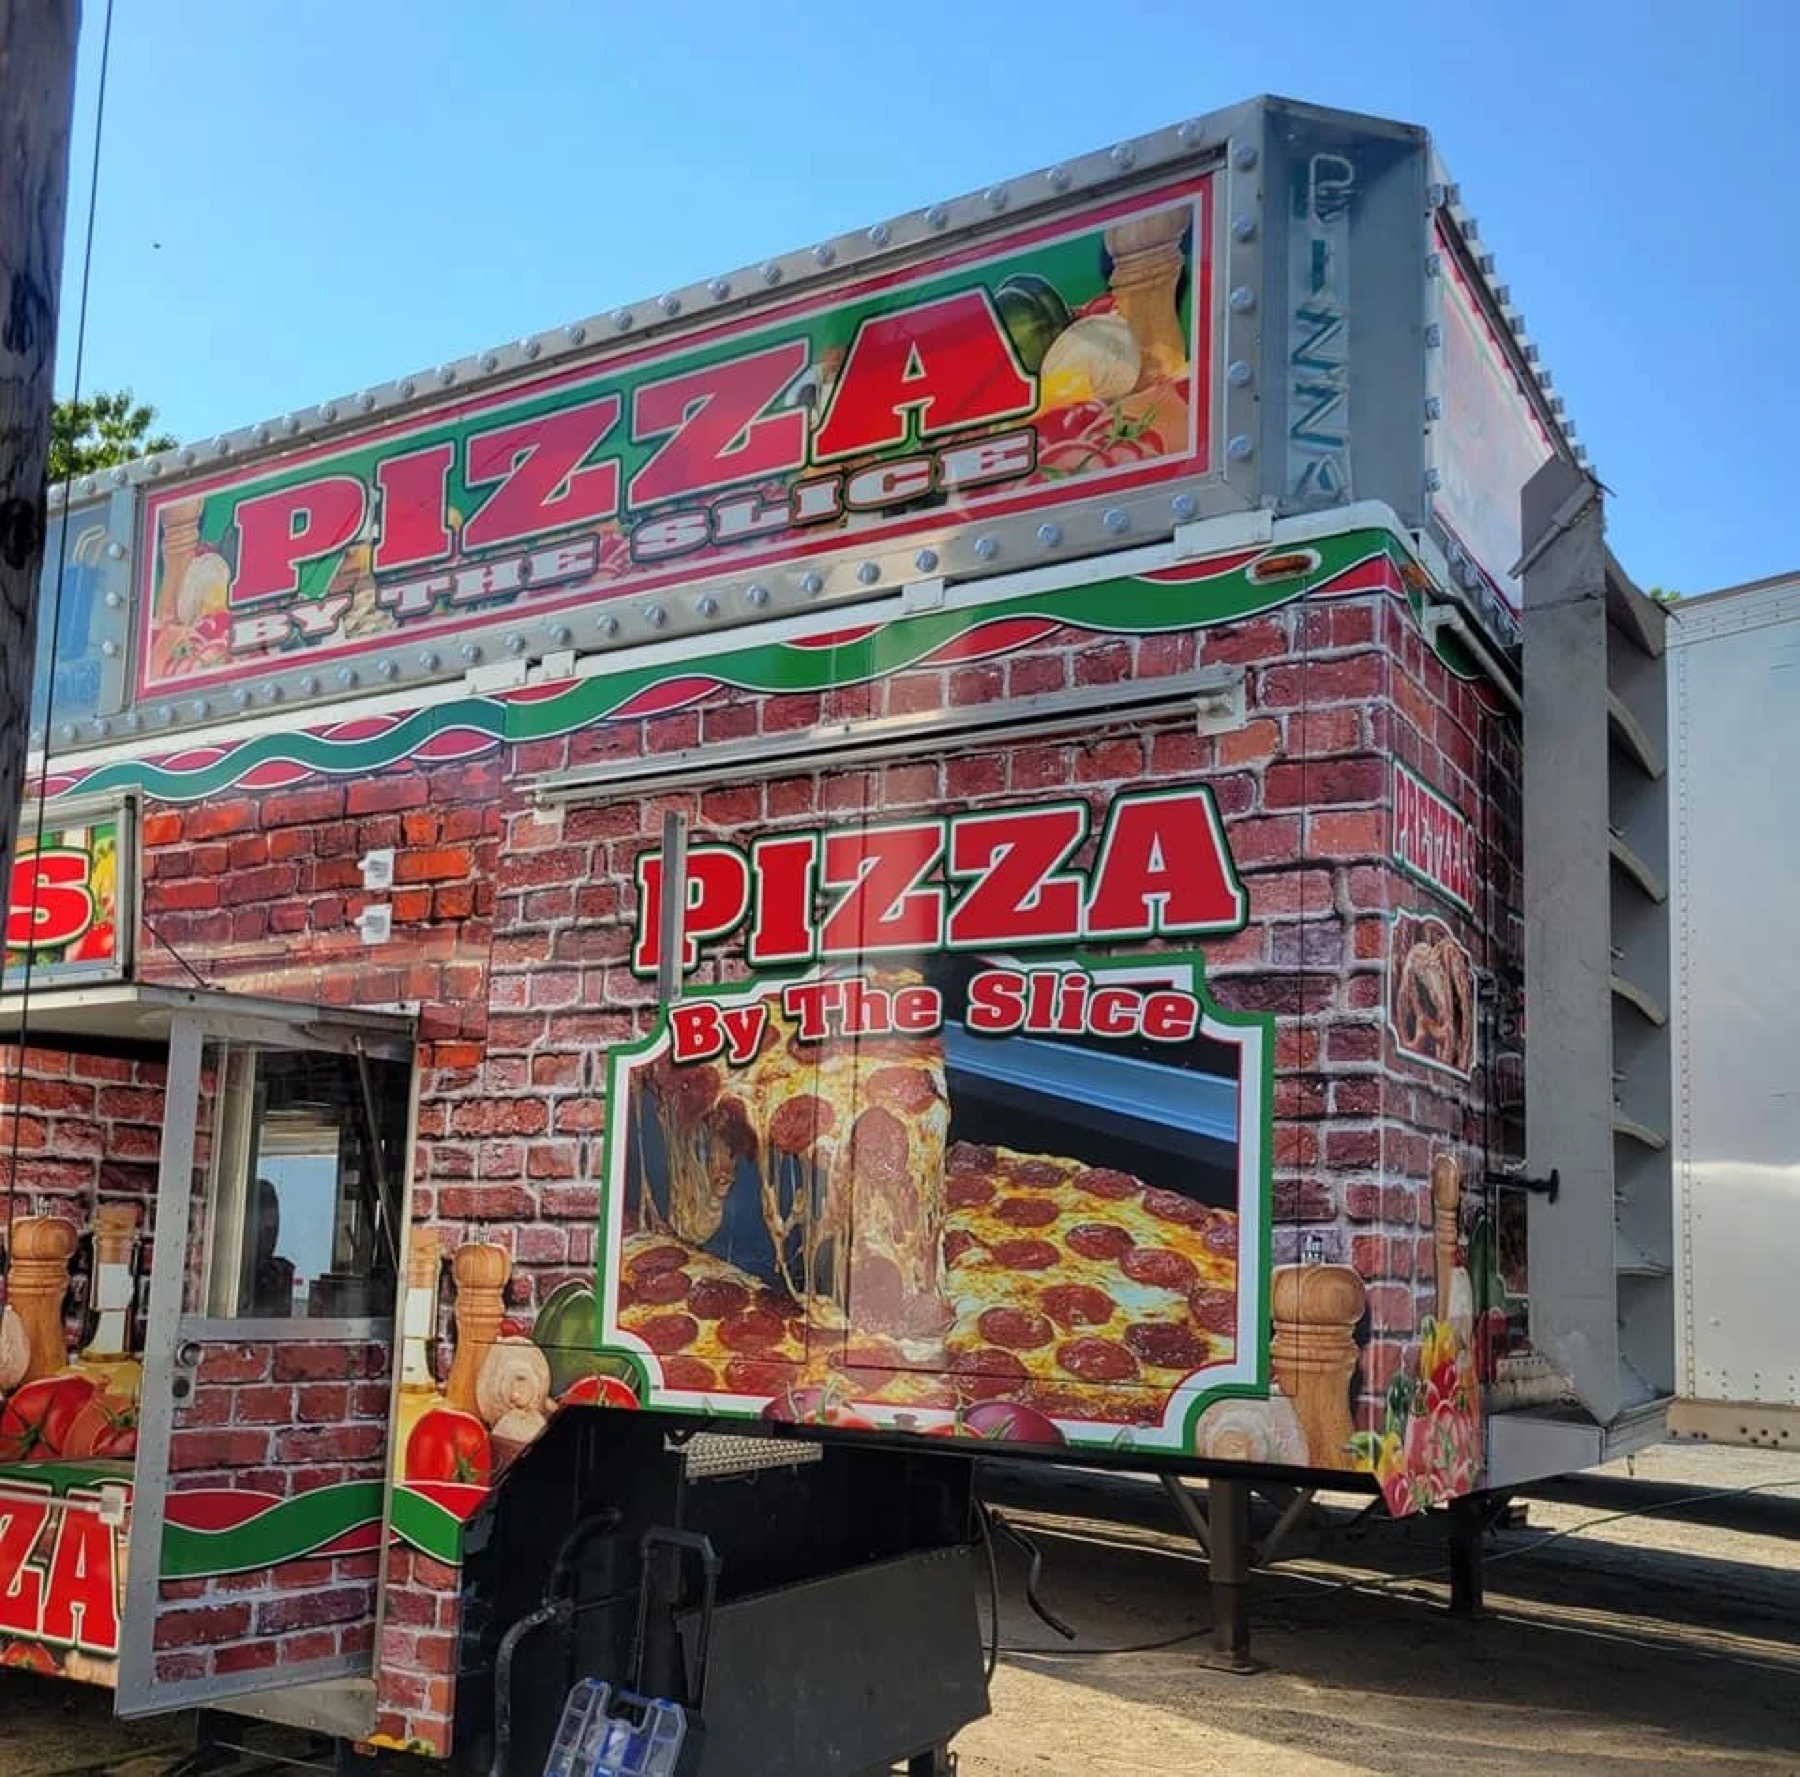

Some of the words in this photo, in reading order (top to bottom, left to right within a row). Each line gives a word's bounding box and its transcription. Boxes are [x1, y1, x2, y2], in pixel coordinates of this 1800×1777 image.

[228, 286, 1038, 607] PIZZA
[230, 596, 350, 653] BY
[376, 534, 600, 618] THE
[631, 428, 1037, 563] SLICE
[634, 785, 1247, 975] PIZZA
[669, 1001, 766, 1064] By
[784, 974, 942, 1038] The
[967, 971, 1202, 1041] Slice
